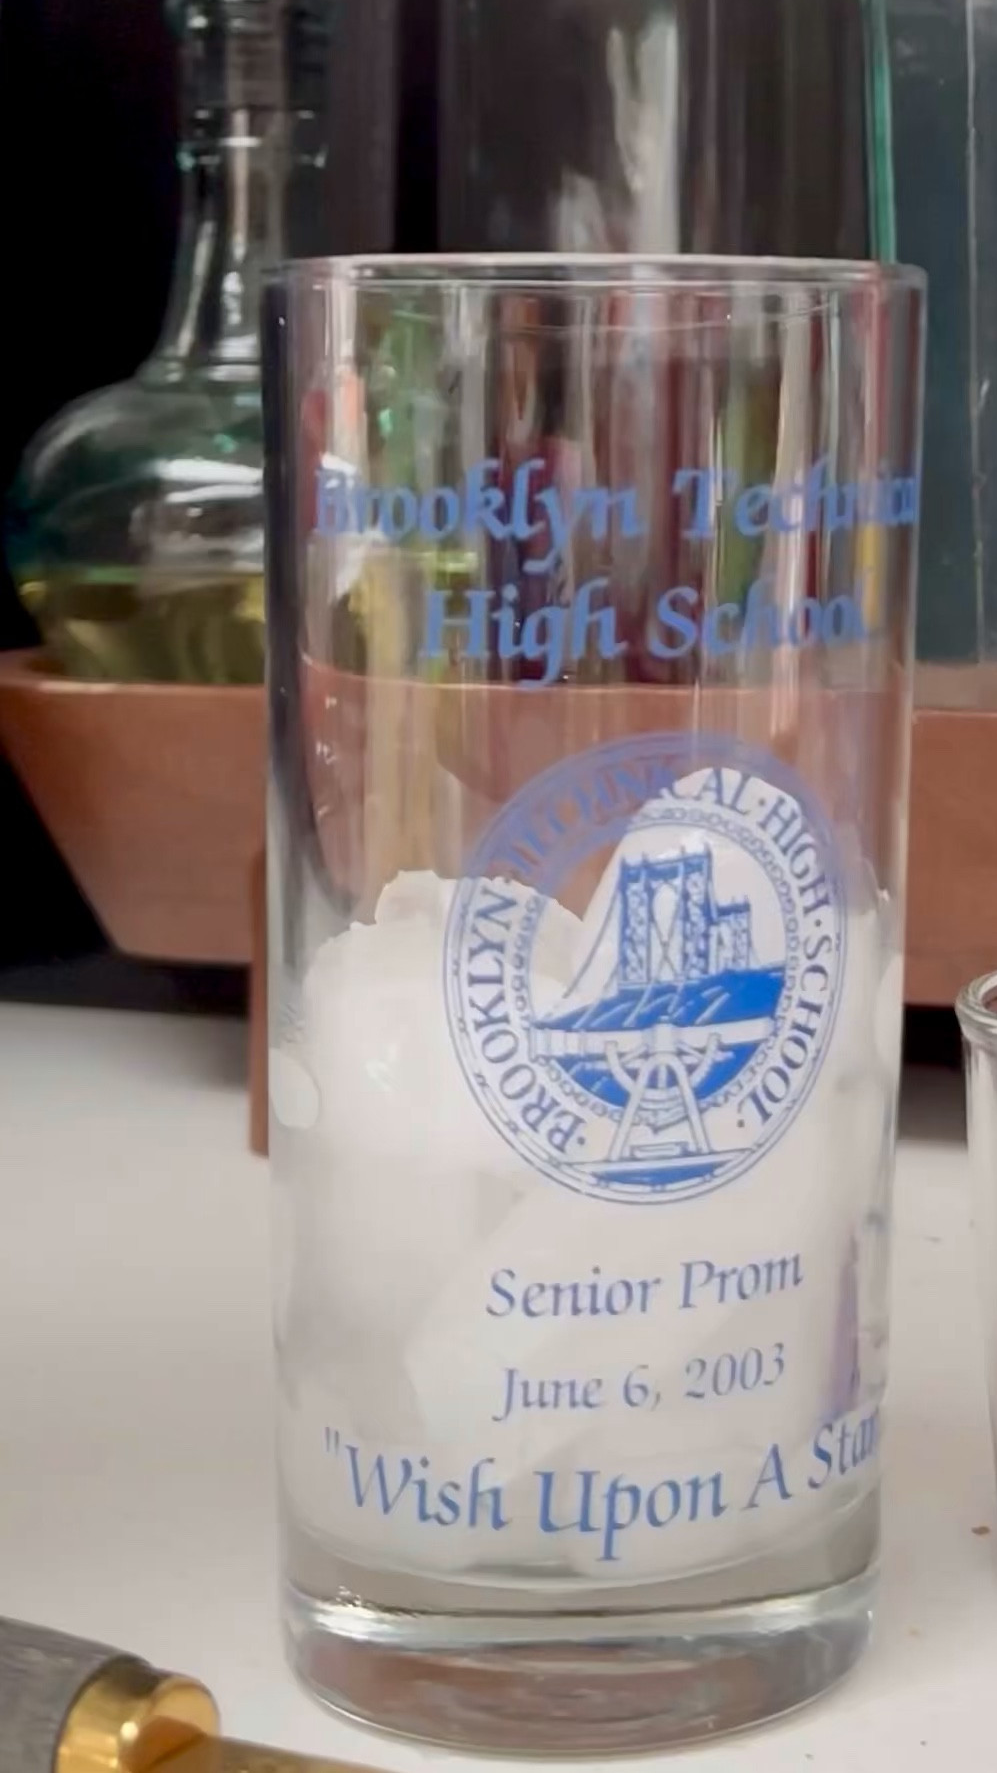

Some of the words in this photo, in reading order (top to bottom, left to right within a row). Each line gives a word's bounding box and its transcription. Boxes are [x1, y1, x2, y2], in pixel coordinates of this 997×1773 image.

[315, 457, 641, 575] Brooklyn
[420, 577, 628, 690] High
[648, 577, 869, 660] School
[757, 795, 834, 917] HIGH
[467, 884, 589, 1155] BROOKLYN
[745, 933, 831, 1125] SCHOOL
[485, 1266, 662, 1318] Senior
[679, 1252, 804, 1311] Prom
[491, 1366, 603, 1422] June
[622, 1364, 662, 1412] 6,
[684, 1342, 786, 1400] 2003
[533, 1468, 728, 1563] Upon
[741, 1443, 793, 1511] A
